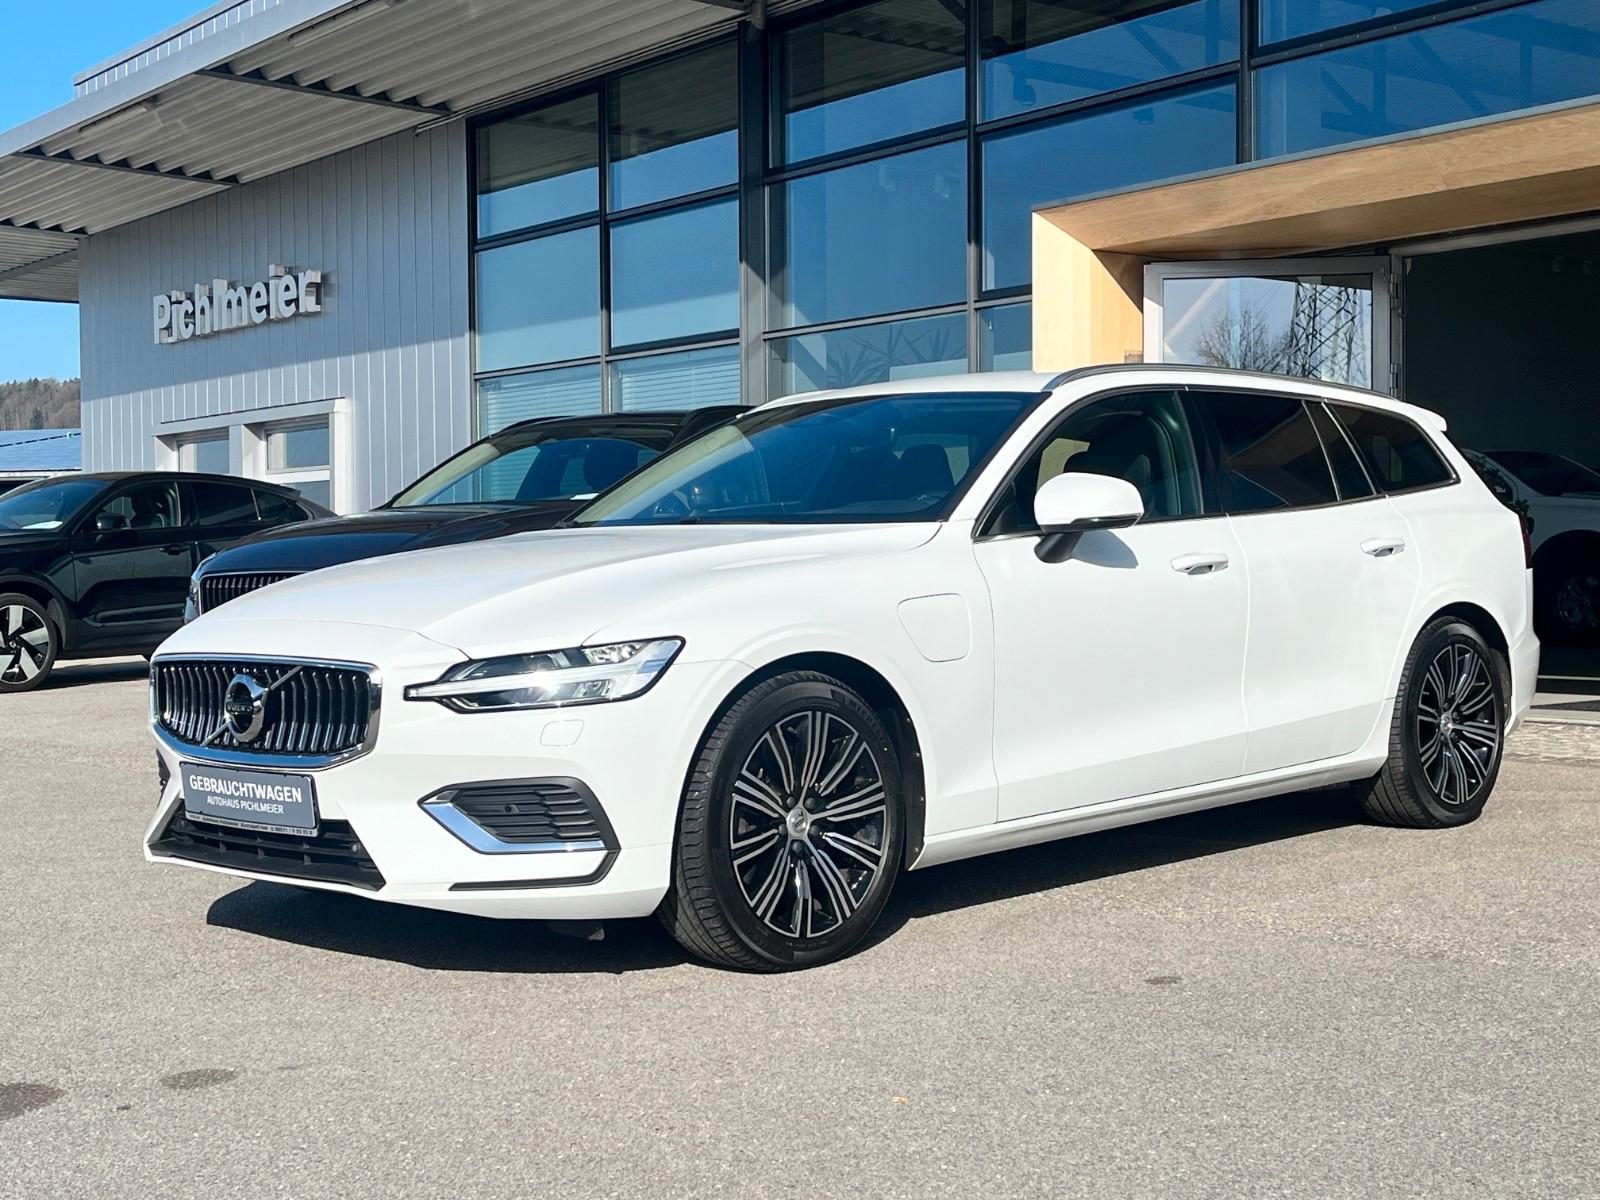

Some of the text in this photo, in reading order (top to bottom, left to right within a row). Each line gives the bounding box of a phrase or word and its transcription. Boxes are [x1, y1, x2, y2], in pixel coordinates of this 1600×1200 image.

[153, 264, 321, 344] Pichlmeier
[189, 774, 302, 803] GEBRAUCHTWAGEN
[207, 795, 284, 814] AUTOHAUS PICHLMEIER
